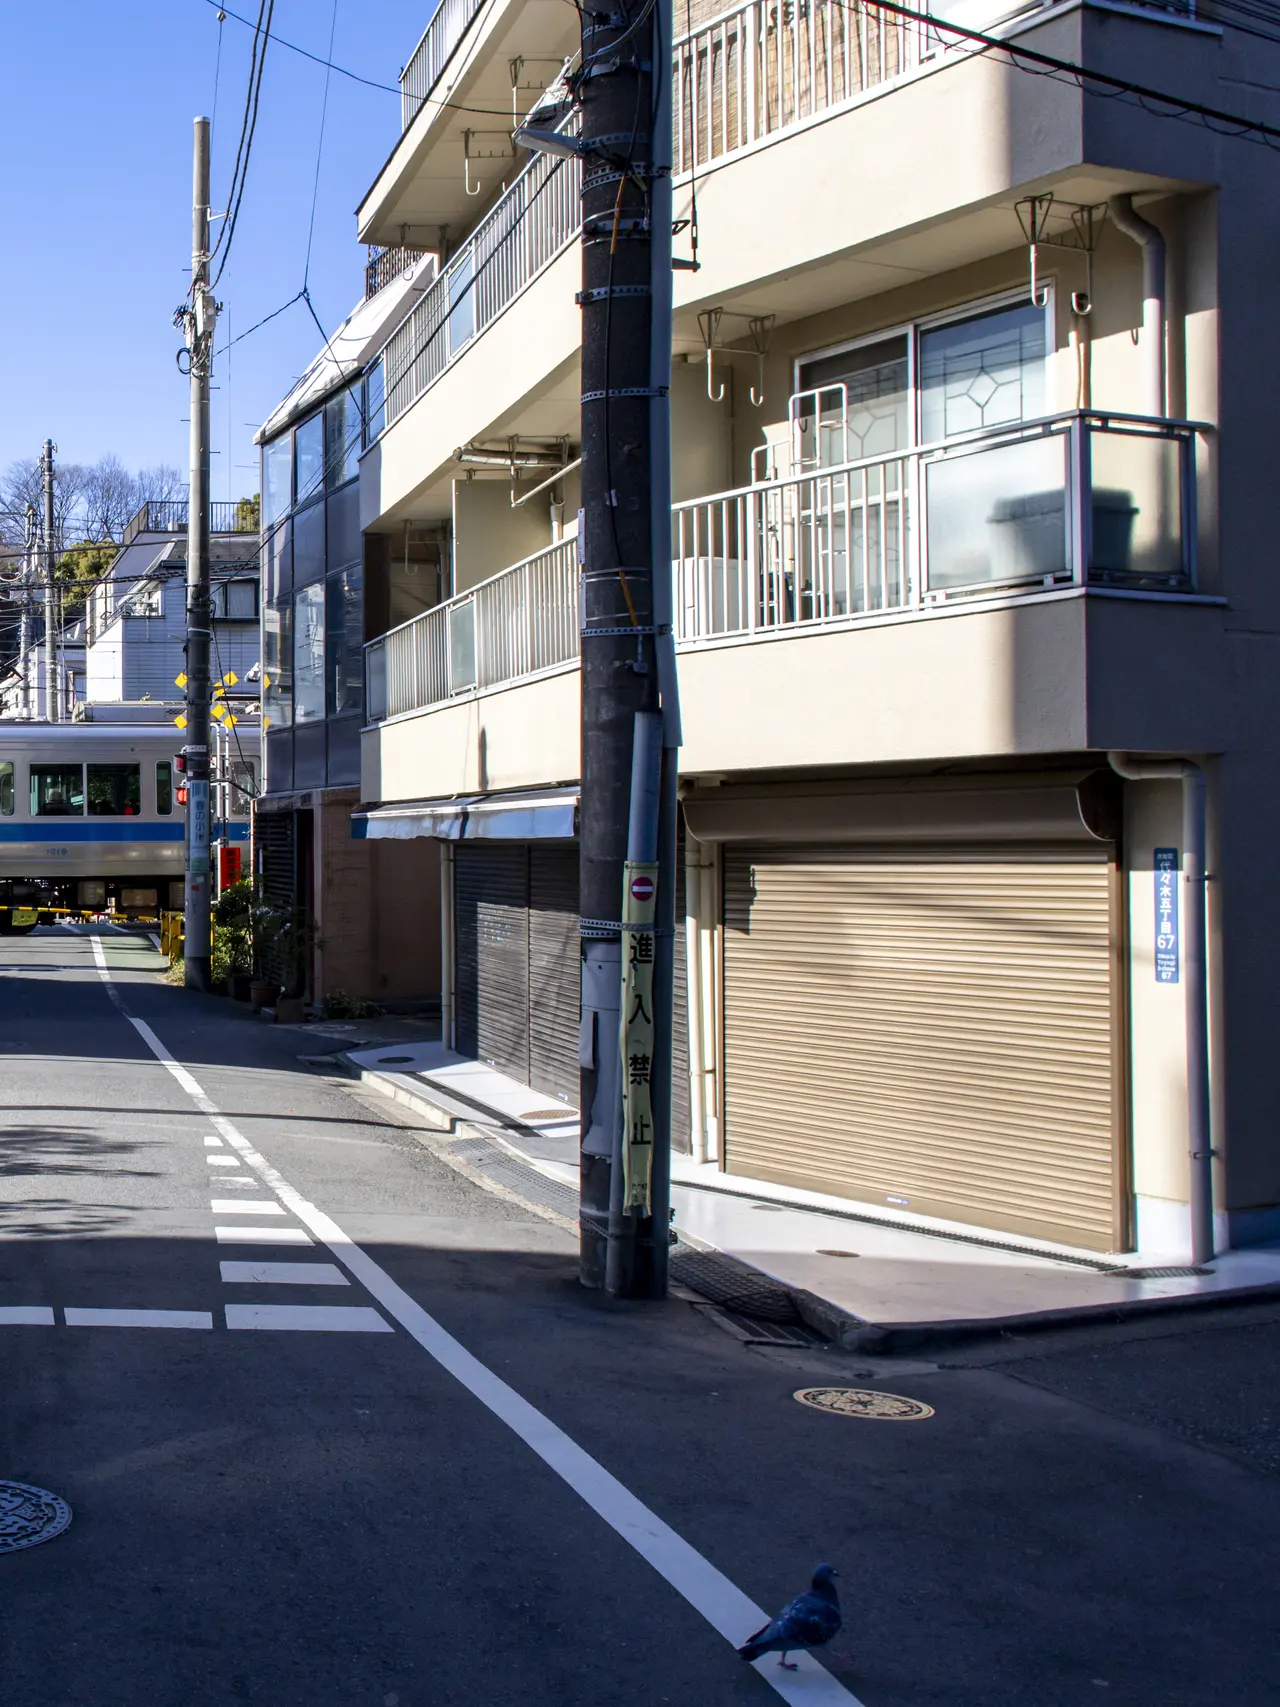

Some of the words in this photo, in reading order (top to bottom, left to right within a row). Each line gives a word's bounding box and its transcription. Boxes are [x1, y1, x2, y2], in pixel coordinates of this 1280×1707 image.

[1160, 862, 1172, 934] 代々木五丁目
[1157, 935, 1175, 949] 67
[1161, 971, 1172, 980] 67
[629, 933, 653, 1146] 進入禁止
